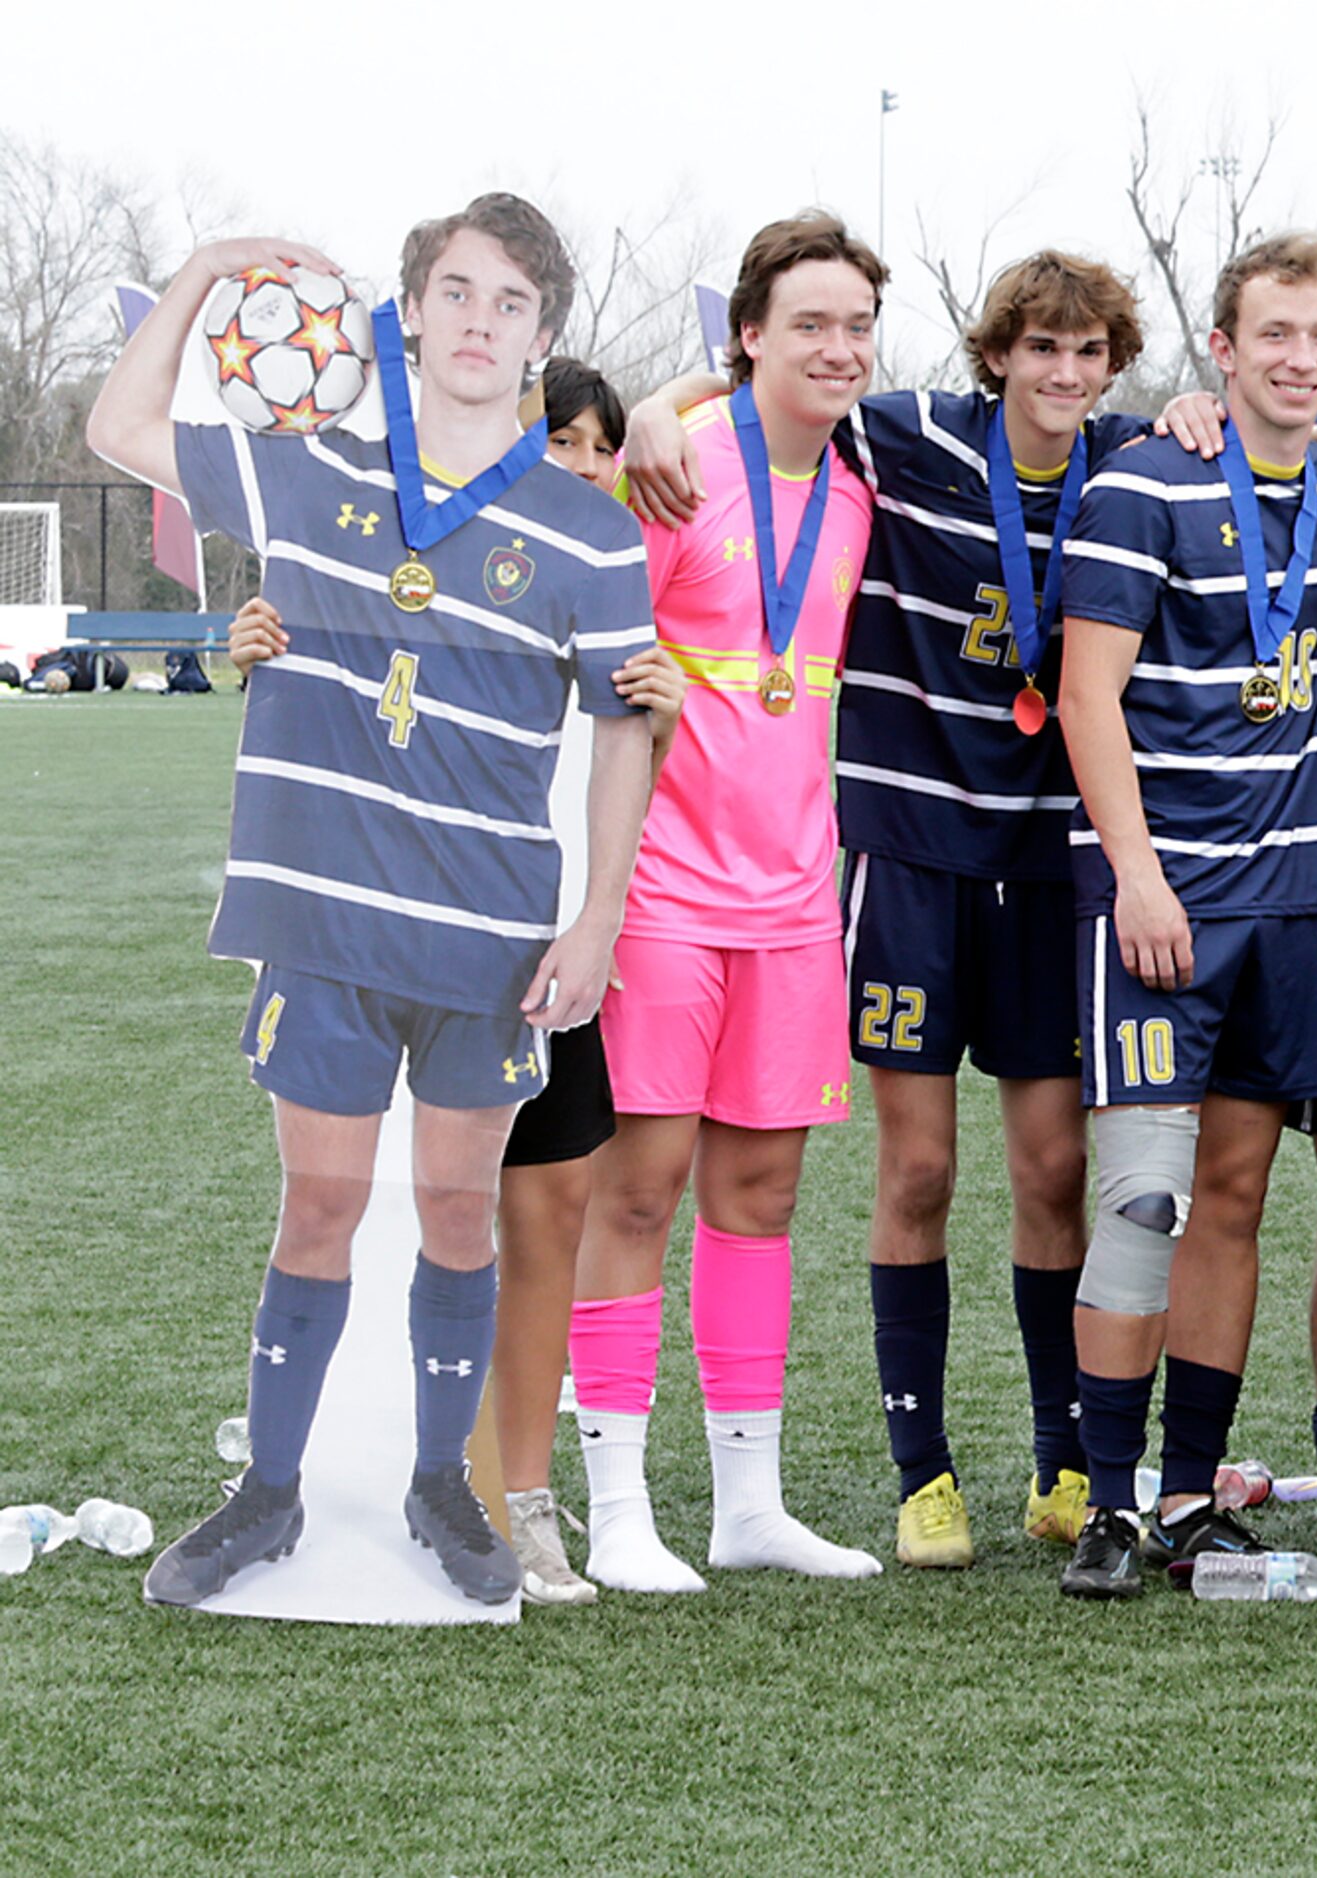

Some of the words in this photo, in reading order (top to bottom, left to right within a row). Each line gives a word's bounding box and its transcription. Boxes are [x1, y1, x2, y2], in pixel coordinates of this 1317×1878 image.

[376, 648, 420, 750] 4
[256, 991, 286, 1067] 4
[858, 981, 927, 1052] 22
[1116, 1017, 1176, 1087] 10
